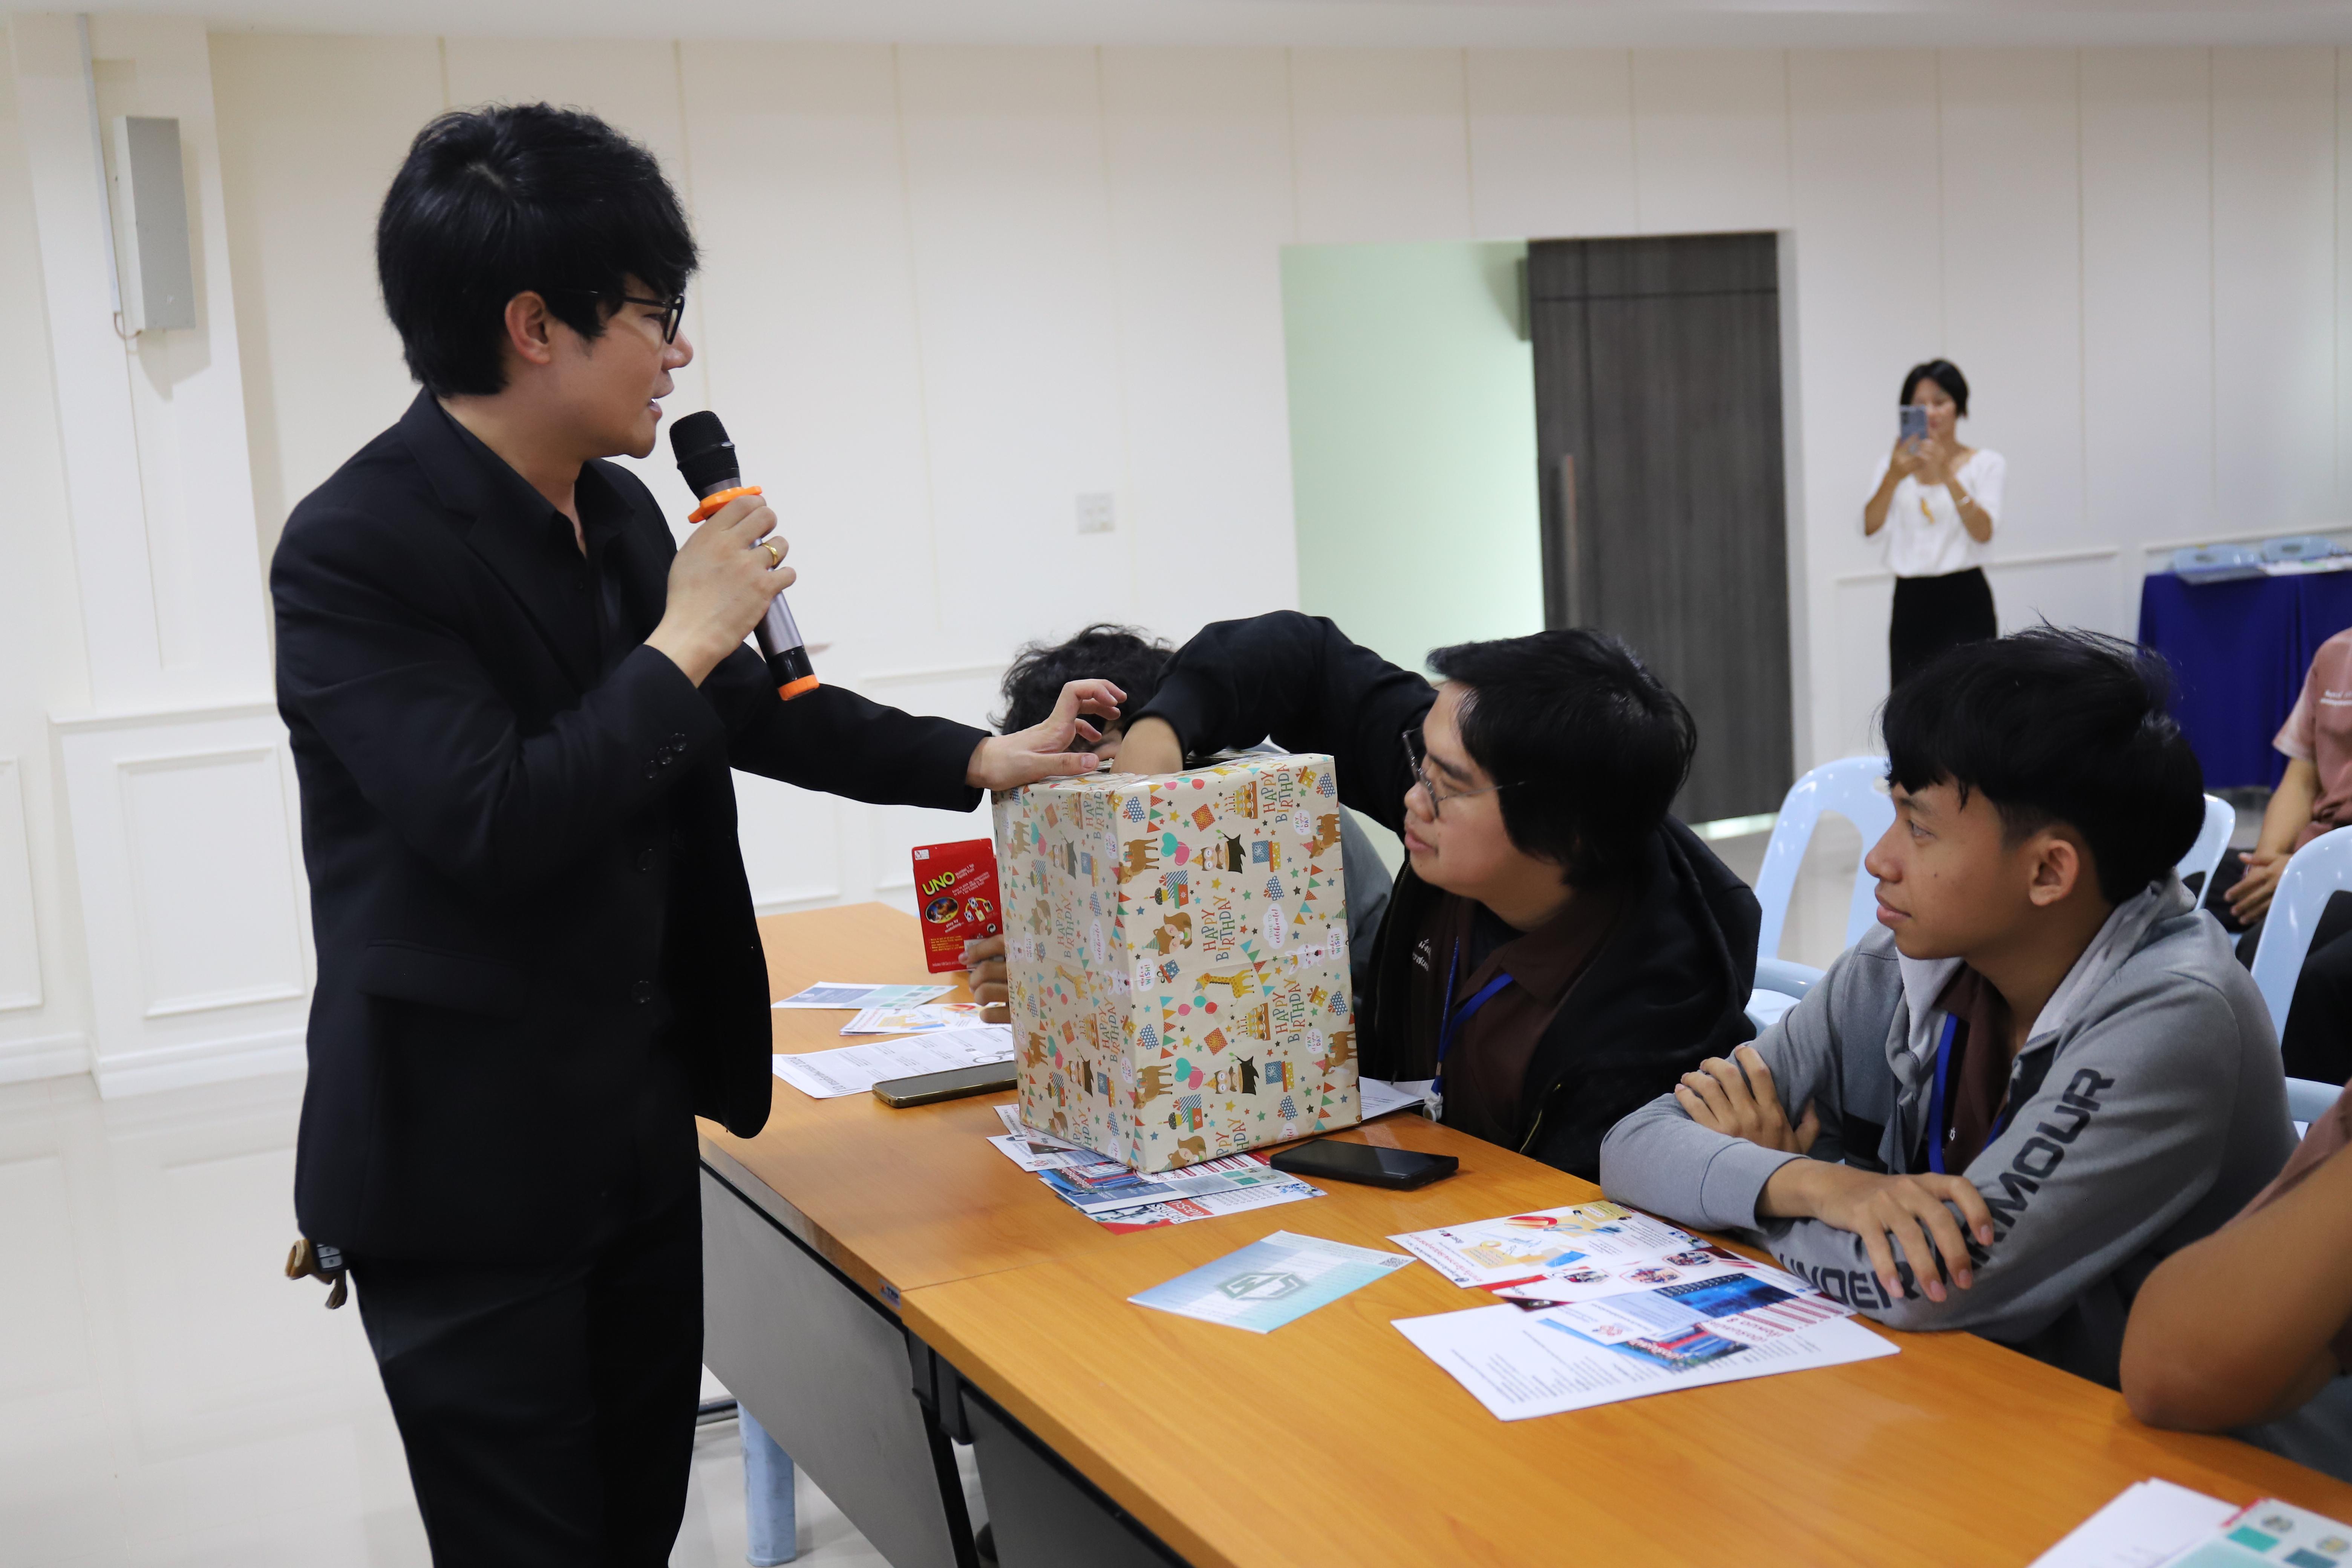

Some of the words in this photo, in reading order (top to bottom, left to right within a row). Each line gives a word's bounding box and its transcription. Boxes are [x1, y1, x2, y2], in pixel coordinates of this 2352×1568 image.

[1260, 770, 1277, 813] HAPPY
[1267, 762, 1294, 824] BIRTHDAY
[922, 871, 956, 896] UNO
[1055, 902, 1066, 946] HAPPY
[1061, 894, 1074, 959] BIRTHDAY
[1201, 908, 1218, 952] HAPPY
[1213, 896, 1235, 962] BIRTHDAY
[1271, 909, 1280, 943] celebrate!
[1098, 1006, 1110, 1049] HAPPY
[1104, 997, 1120, 1063] BIRTHDAY
[1272, 992, 1289, 1034] HAPPY
[1283, 978, 1305, 1044] BIRTHDAY
[1078, 1108, 1092, 1147] HDAY
[1216, 1131, 1232, 1156] PPY
[1227, 1118, 1250, 1152] HDAY
